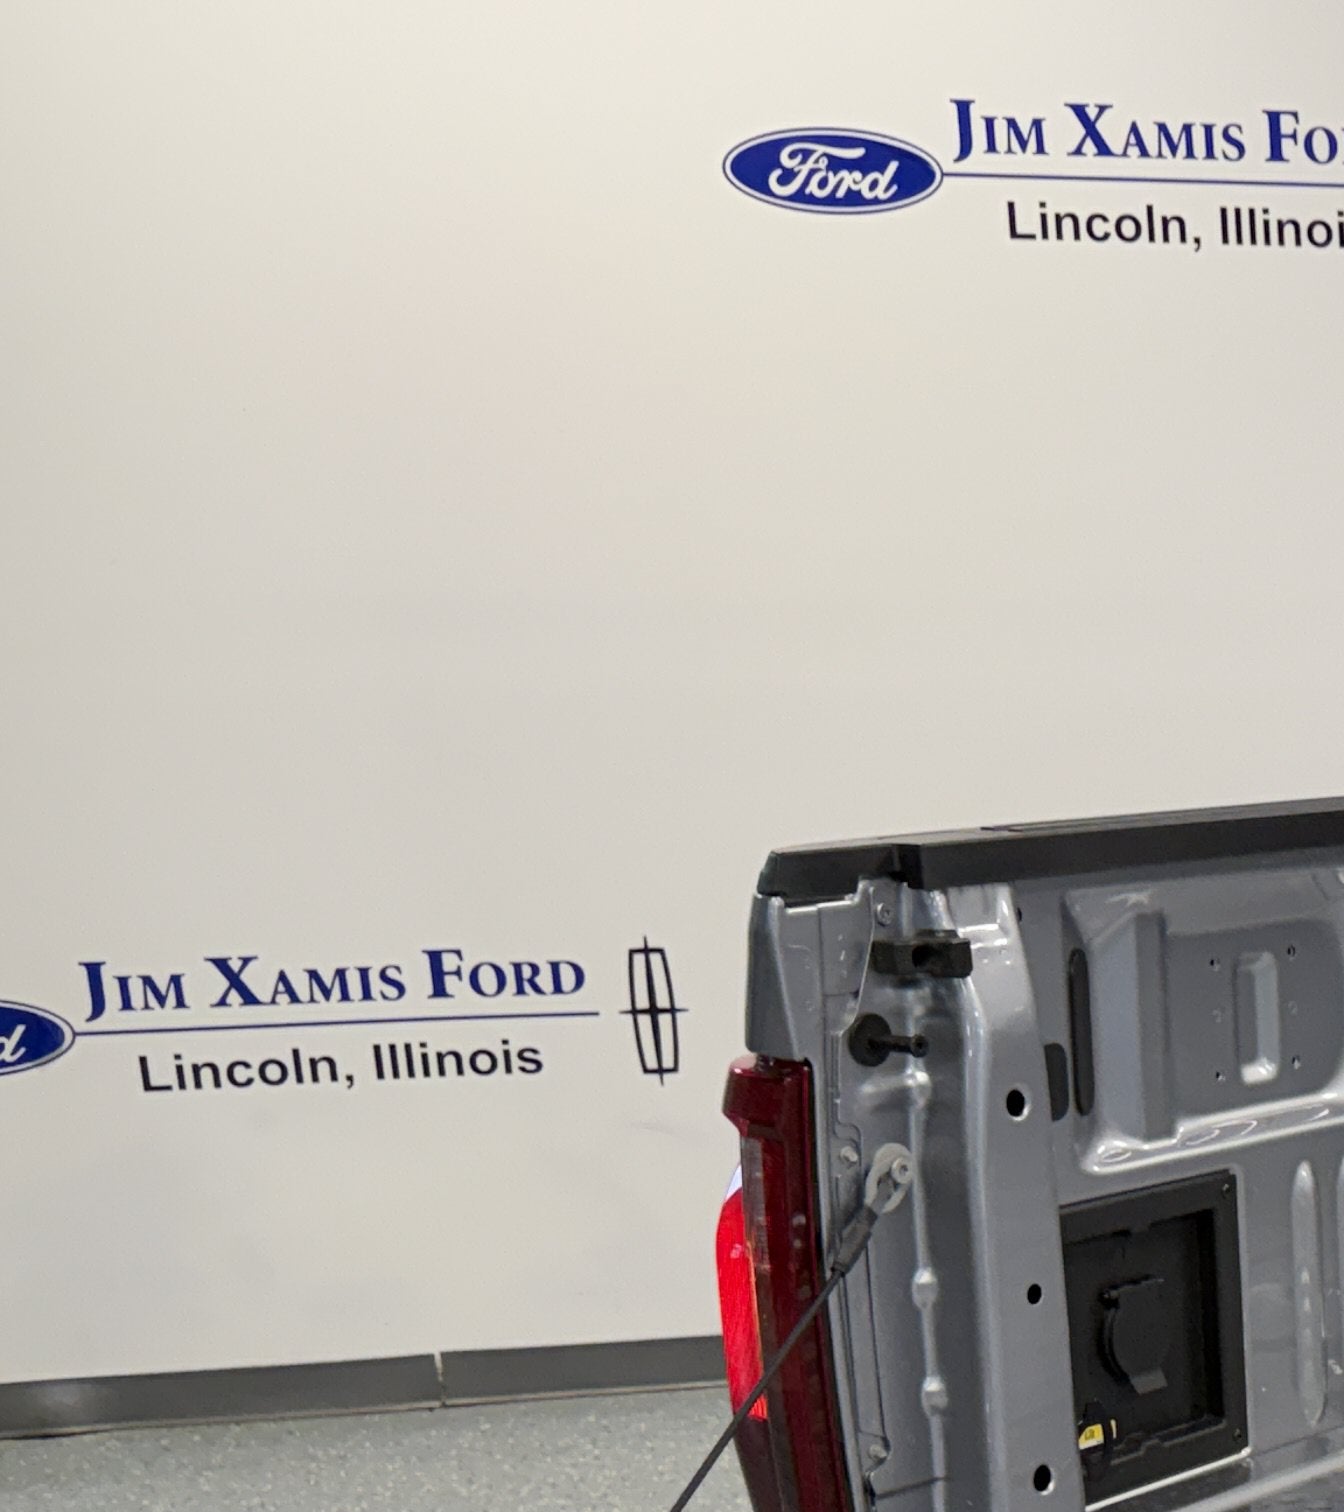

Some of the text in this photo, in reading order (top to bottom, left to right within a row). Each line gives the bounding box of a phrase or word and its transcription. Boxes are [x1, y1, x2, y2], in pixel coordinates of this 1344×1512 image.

[949, 98, 1049, 164] JIM
[1063, 102, 1247, 163] XAMIS
[768, 142, 899, 201] Ford
[1006, 200, 1202, 253] Lincoln,
[77, 948, 586, 1023] JIM XAMIS FORD
[137, 1038, 544, 1093] Lincoln, Illinois
